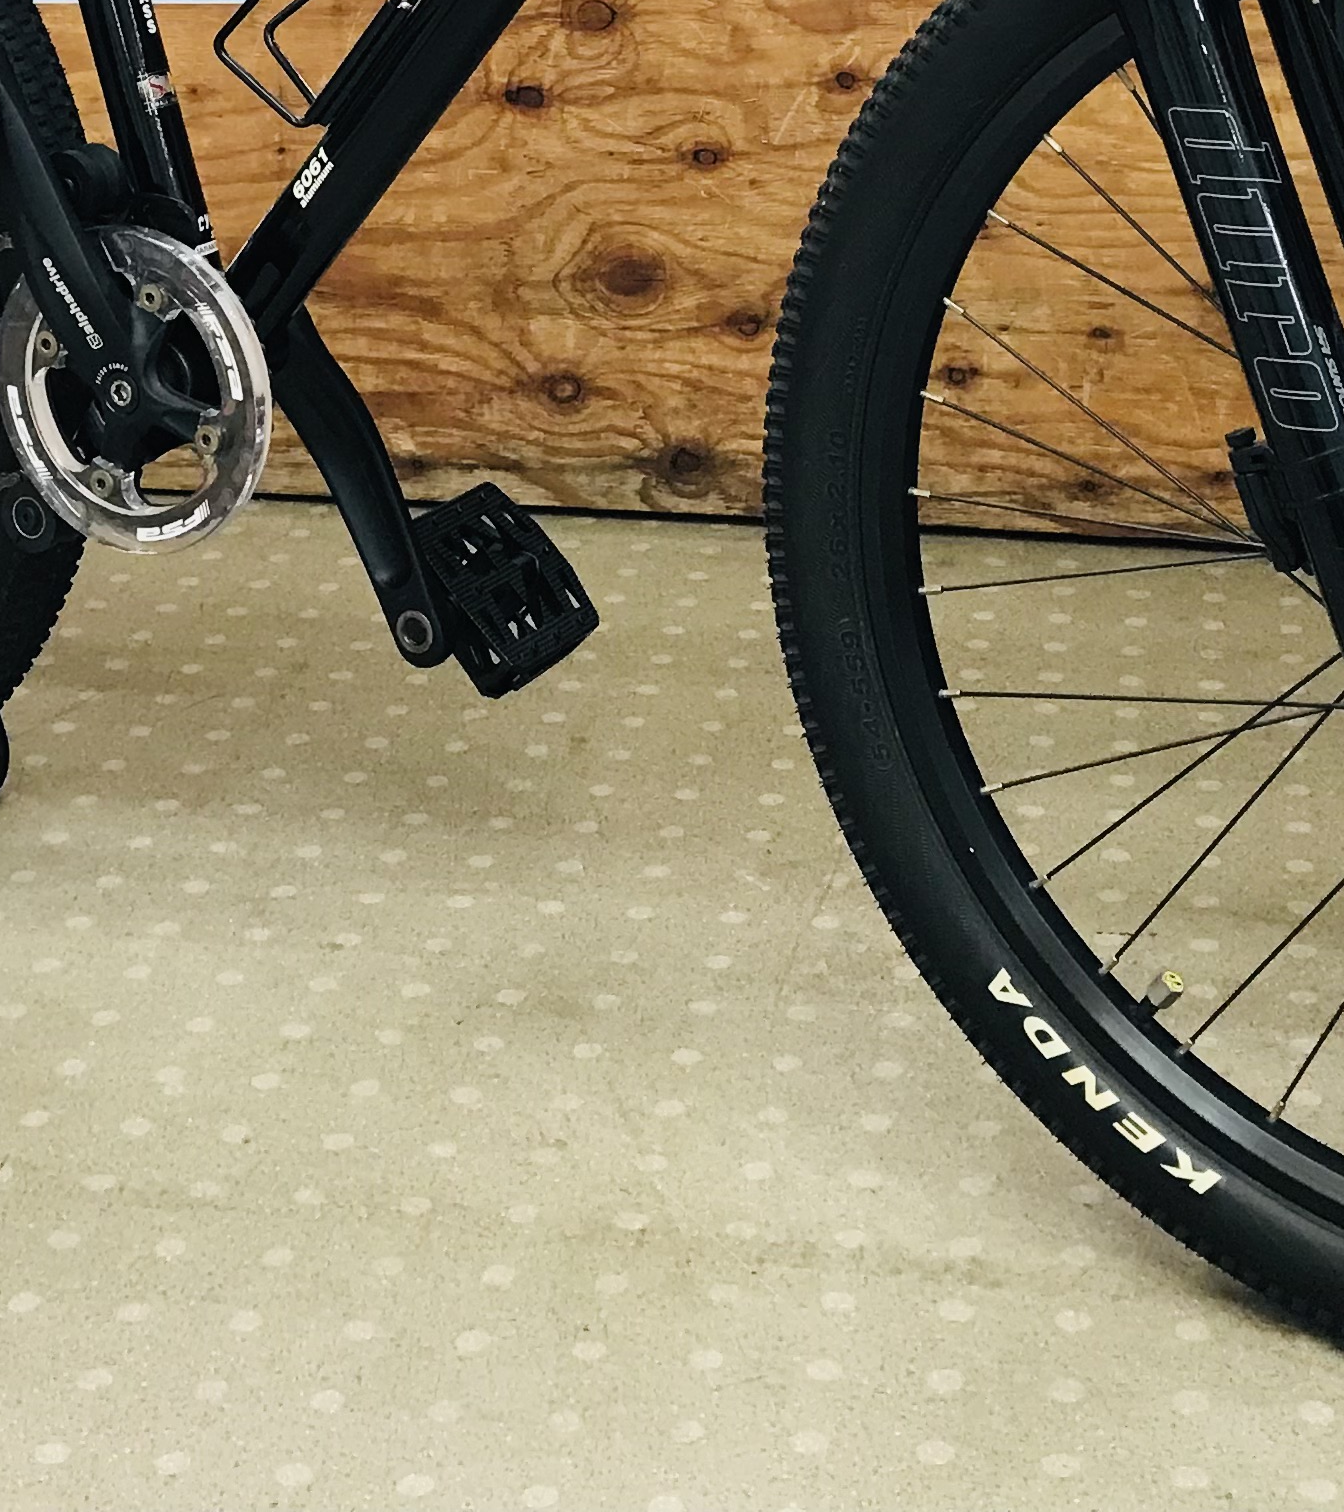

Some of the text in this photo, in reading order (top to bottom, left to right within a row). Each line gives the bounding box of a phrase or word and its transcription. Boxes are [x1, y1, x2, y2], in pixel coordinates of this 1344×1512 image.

[291, 146, 330, 201] 6061
[299, 160, 336, 209] aluminum
[42, 256, 96, 340] alphadrive
[987, 966, 1223, 1196] KENDA
